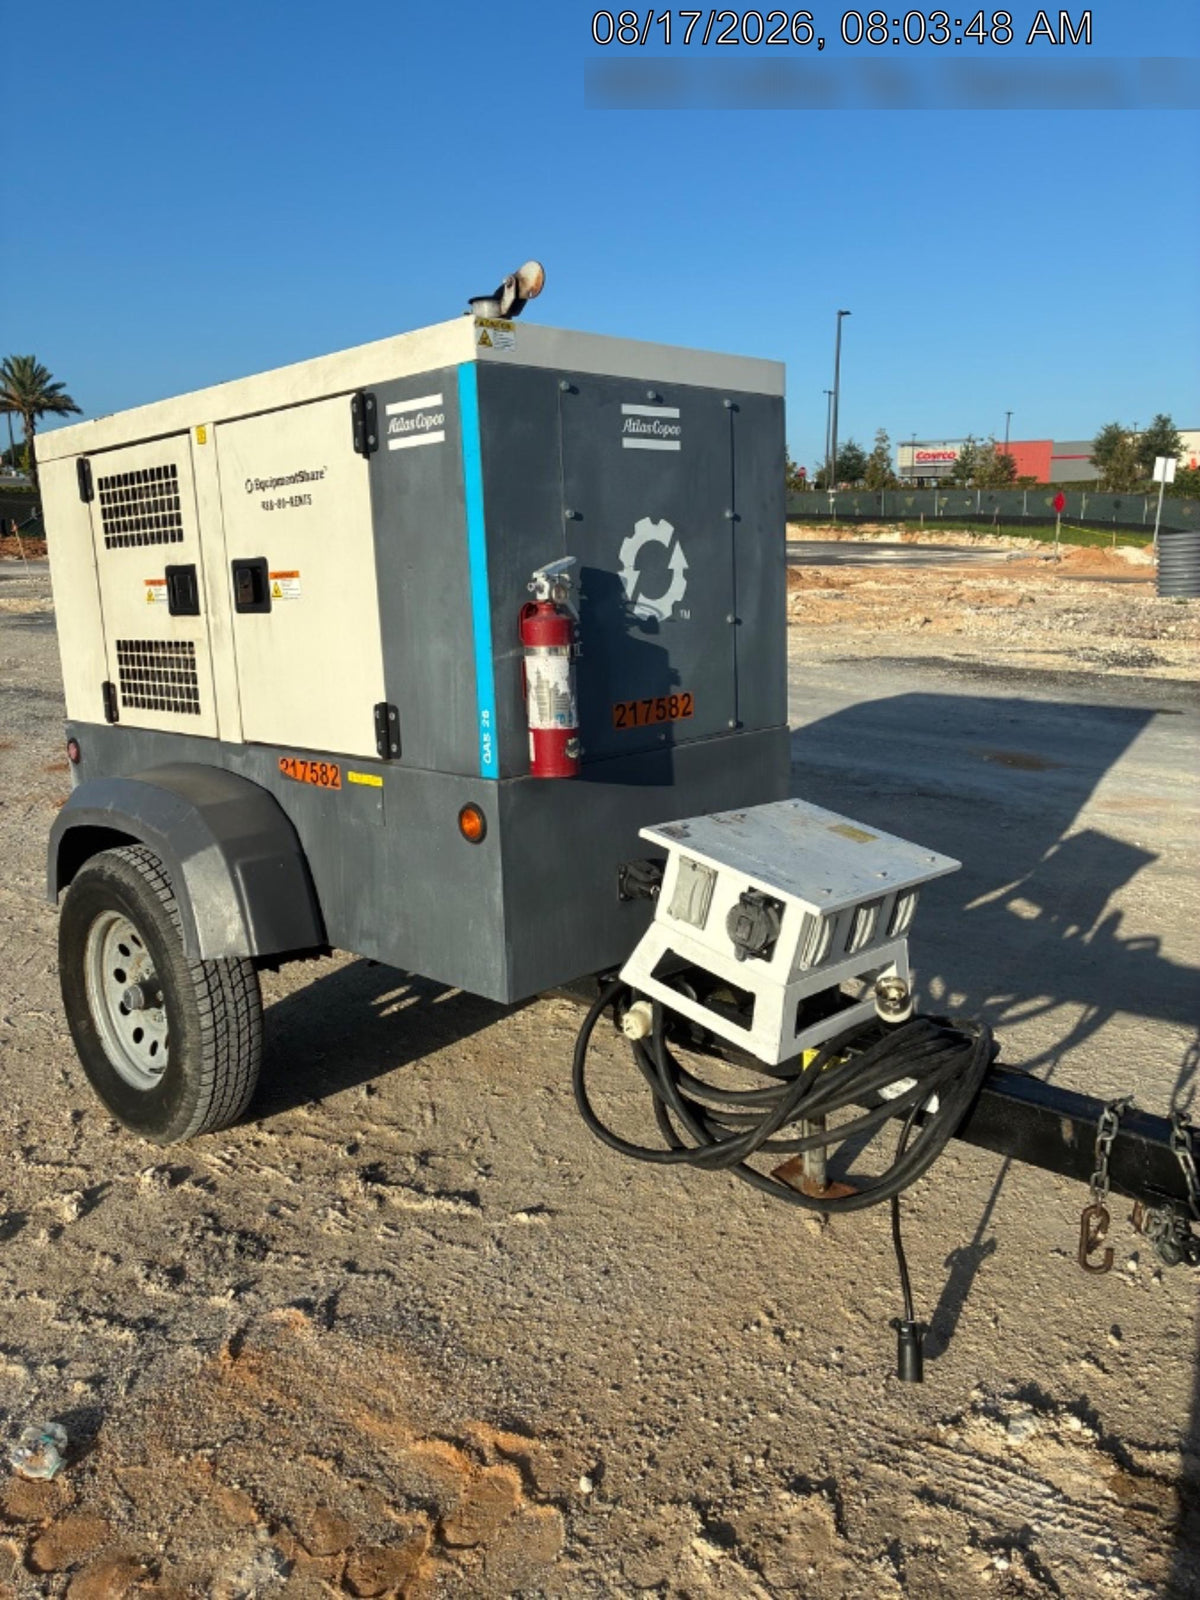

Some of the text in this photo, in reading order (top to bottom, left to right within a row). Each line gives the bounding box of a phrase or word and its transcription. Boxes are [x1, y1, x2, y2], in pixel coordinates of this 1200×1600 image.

[387, 412, 445, 435] Atlas Copco
[622, 418, 682, 438] Atlas Copco
[615, 693, 692, 727] 217582
[280, 758, 340, 787] 217582
